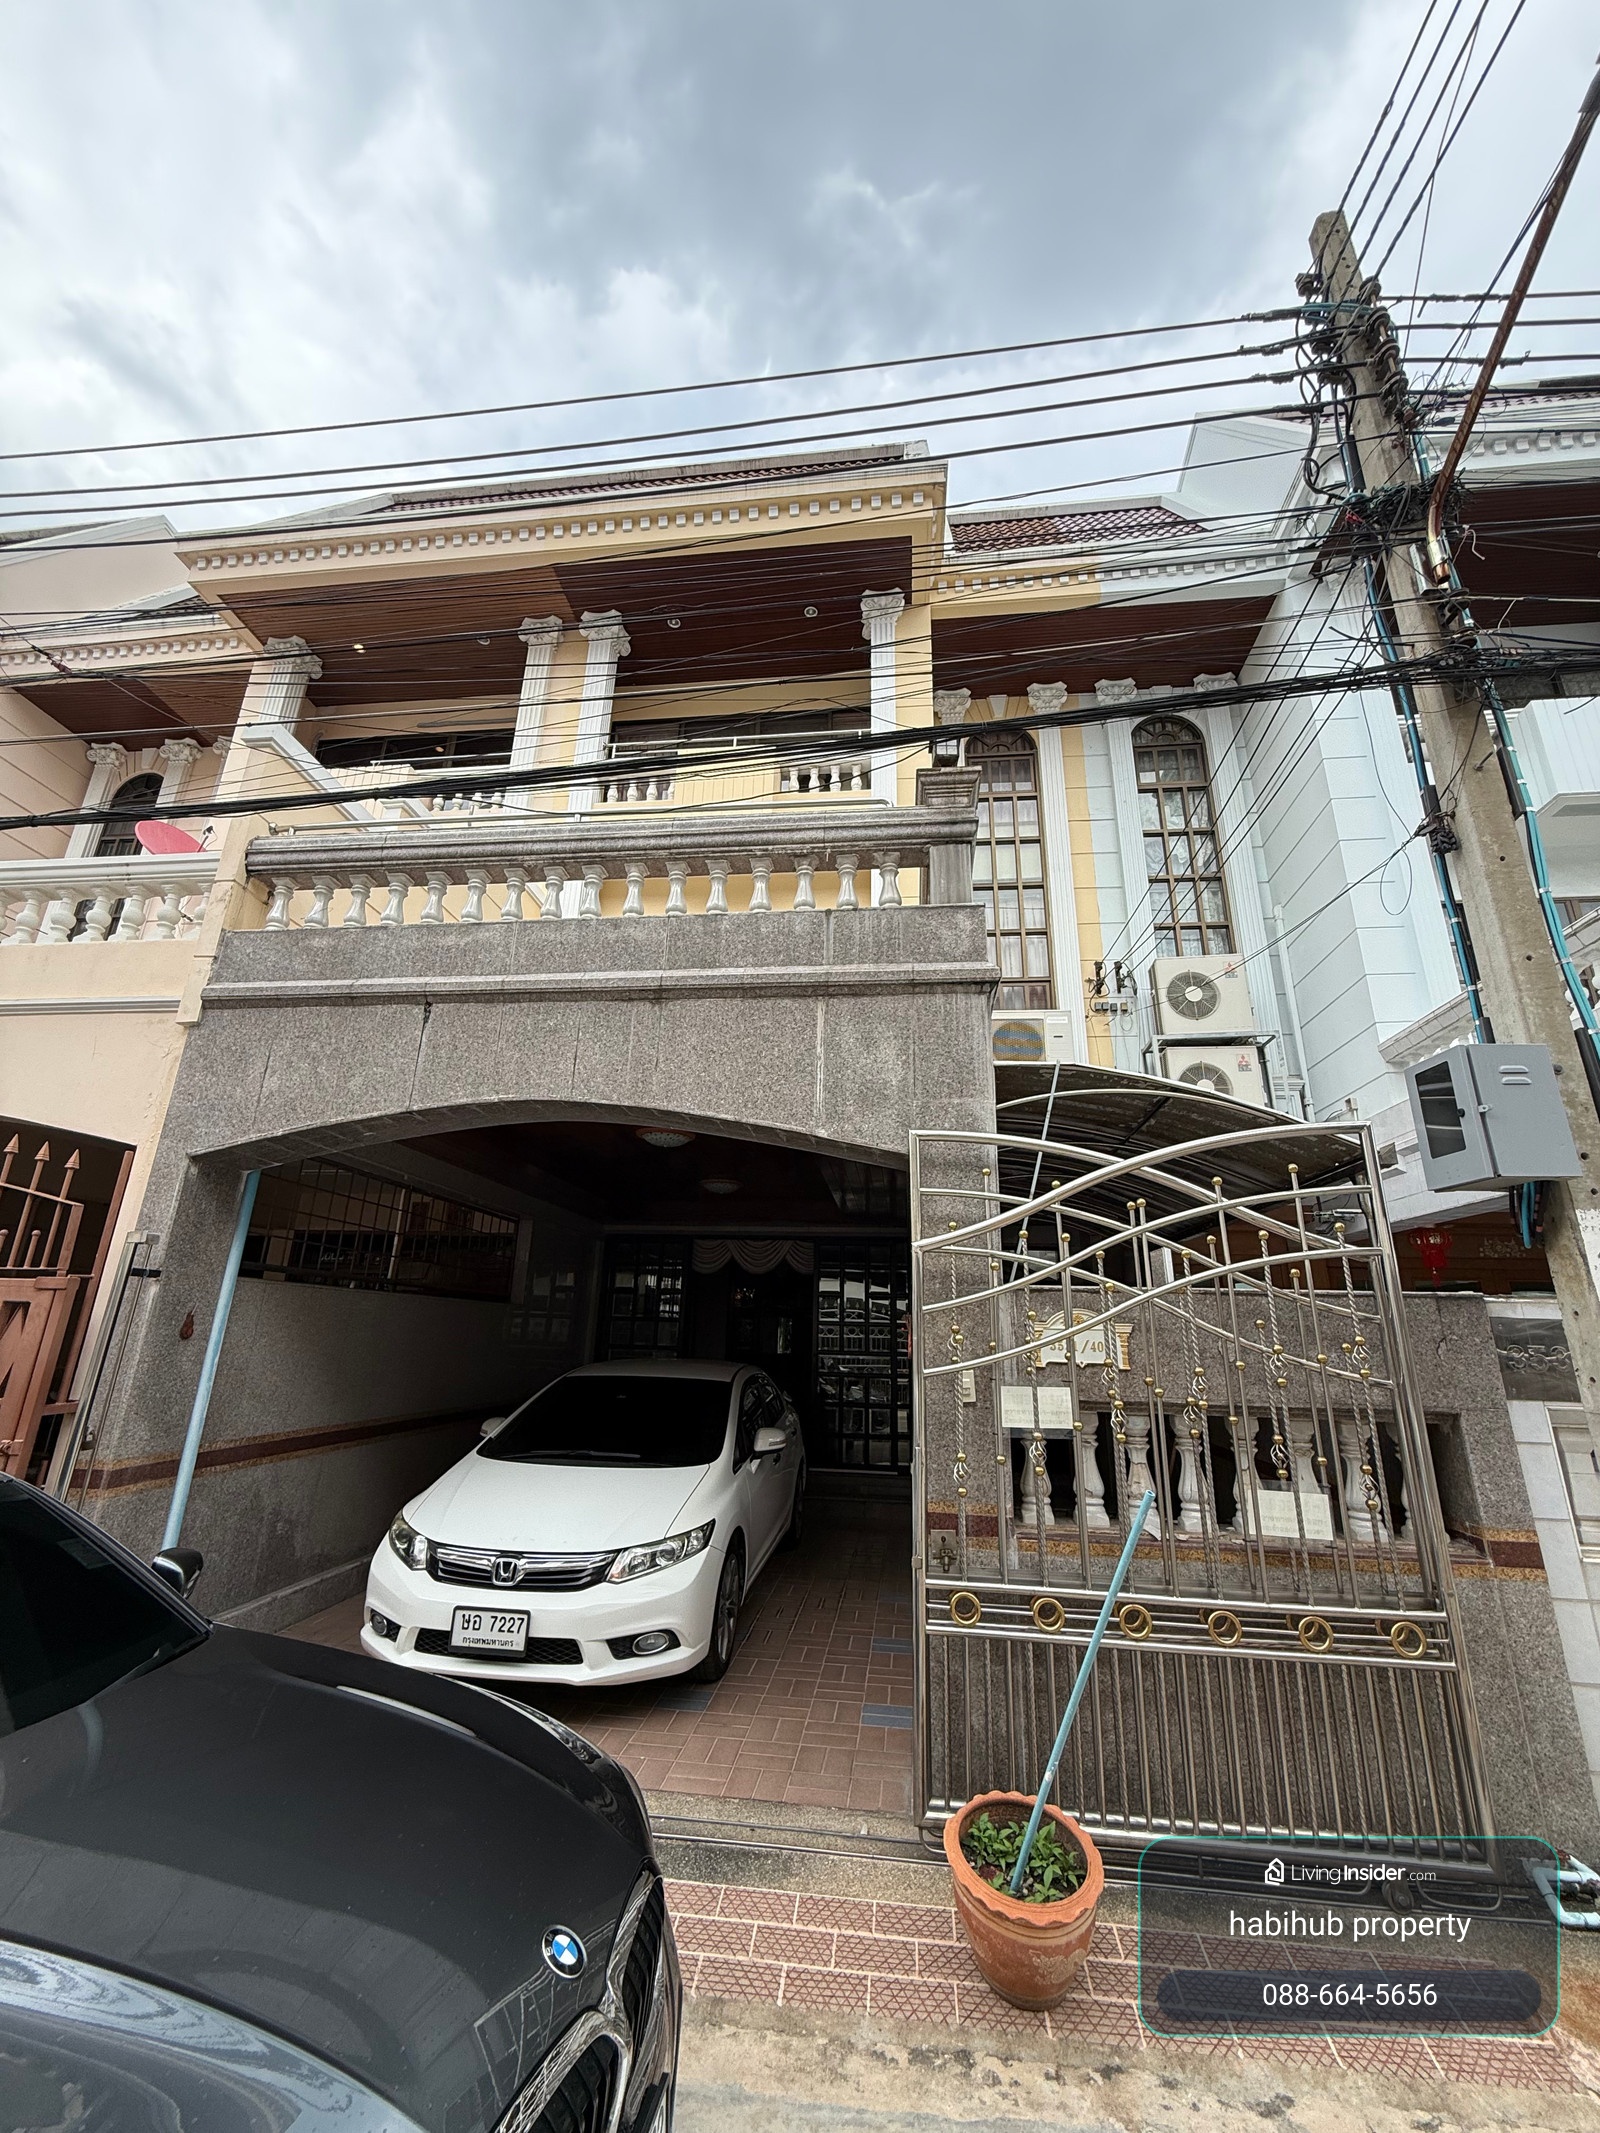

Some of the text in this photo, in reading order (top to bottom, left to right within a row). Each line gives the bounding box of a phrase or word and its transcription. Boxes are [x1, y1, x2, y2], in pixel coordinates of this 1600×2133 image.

[461, 1613, 525, 1635] ษอ 7227
[462, 1636, 514, 1648] กรุงเทพมหานคร
